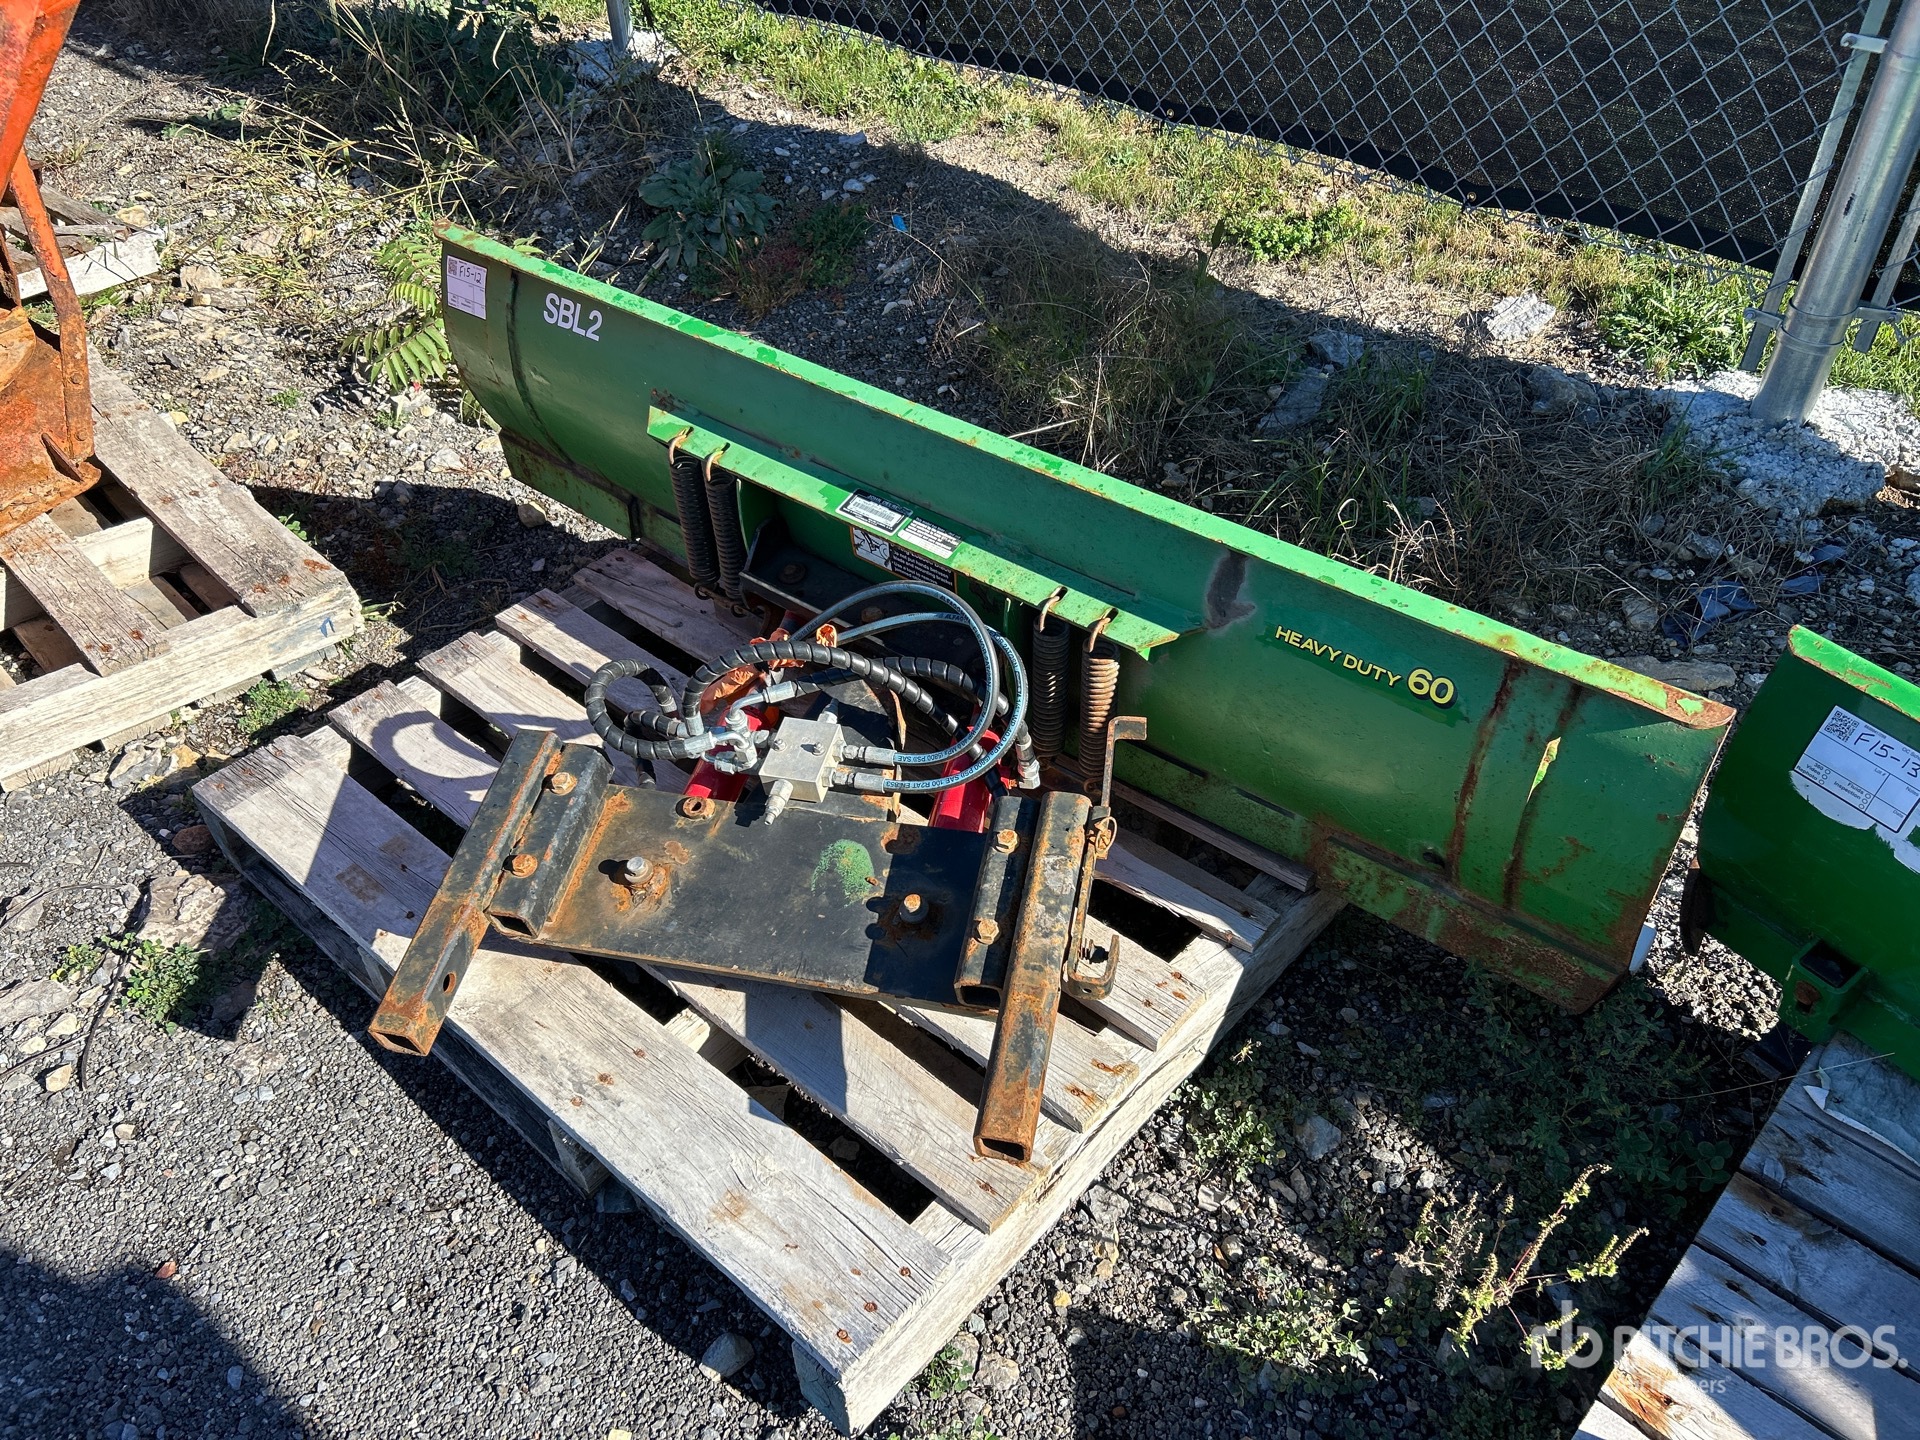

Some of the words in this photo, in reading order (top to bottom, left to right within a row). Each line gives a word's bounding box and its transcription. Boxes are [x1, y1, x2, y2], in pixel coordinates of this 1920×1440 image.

[459, 264, 482, 285] F15-12
[543, 292, 603, 342] SBL2
[1275, 625, 1342, 663] HEAVY
[1342, 653, 1402, 687] DUTY
[1407, 668, 1458, 708] 60
[1854, 732, 1920, 779] F15-13
[945, 774, 959, 783] SAE
[1795, 765, 1818, 781] Rephoto
[1804, 763, 1821, 776] Video
[1832, 780, 1862, 800] Inspection
[1846, 782, 1864, 794] Fluids
